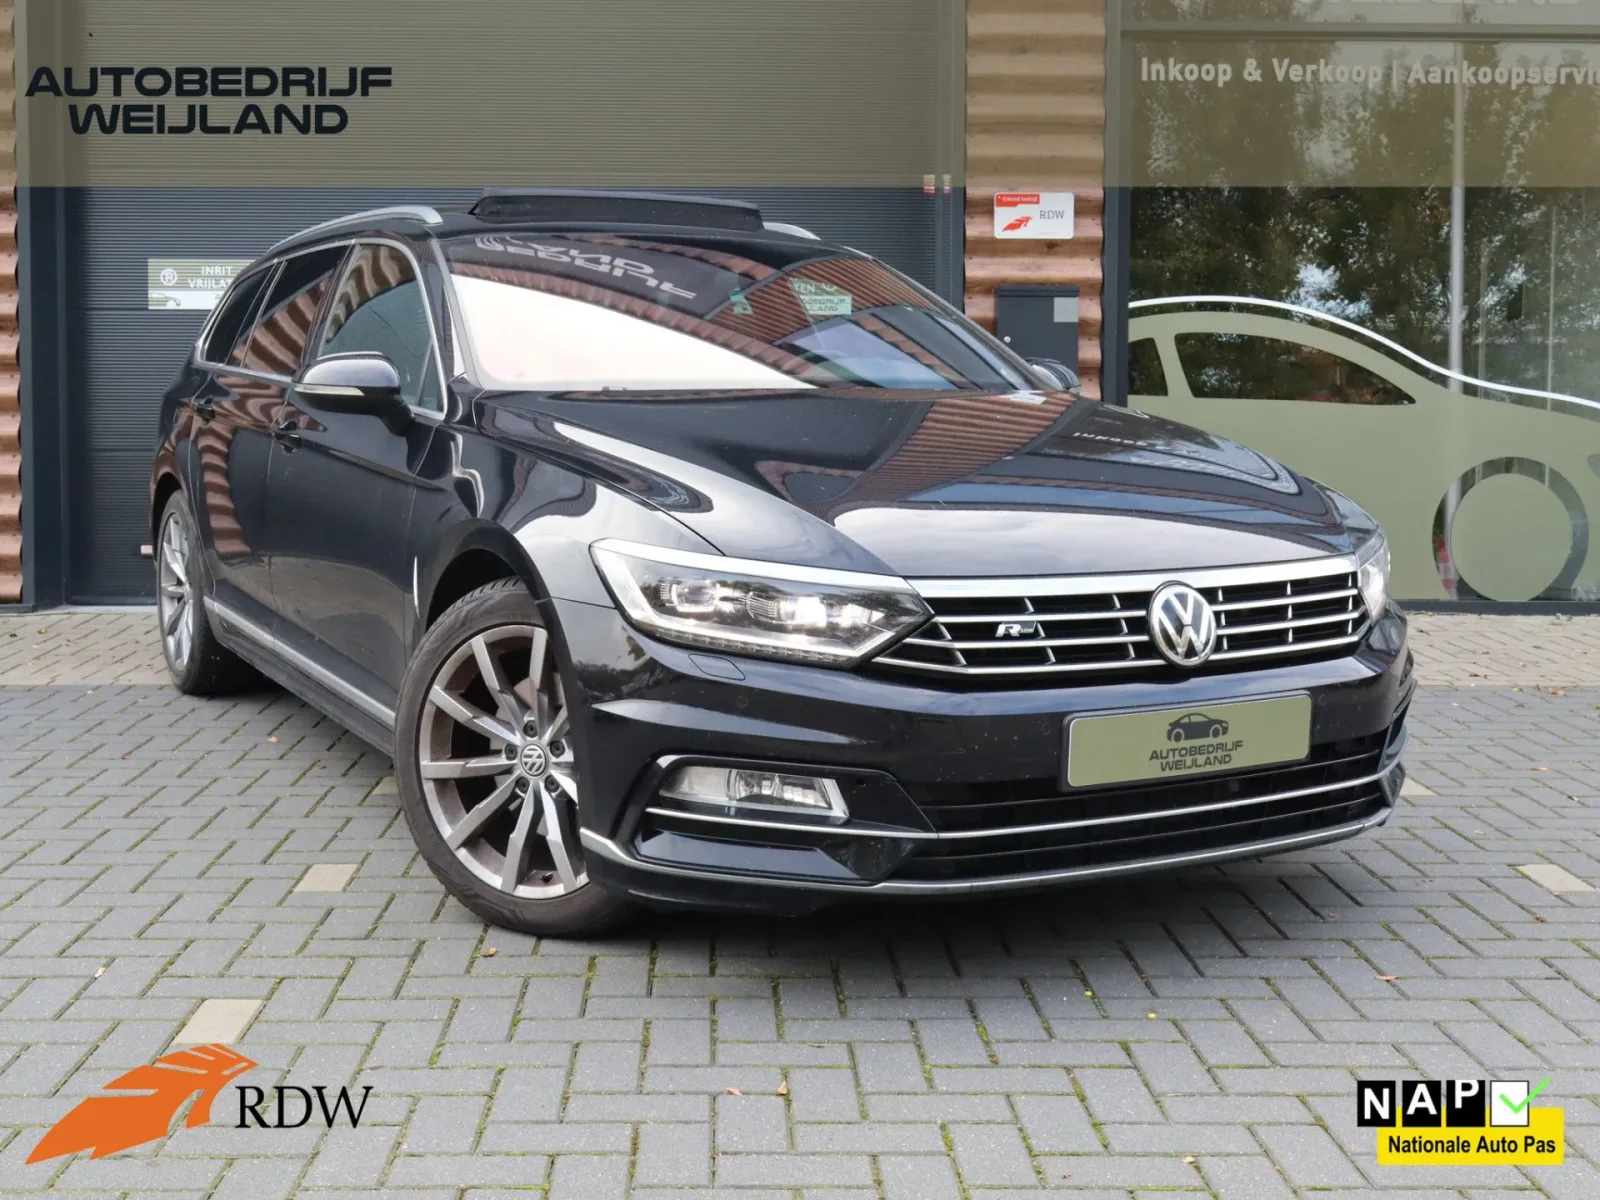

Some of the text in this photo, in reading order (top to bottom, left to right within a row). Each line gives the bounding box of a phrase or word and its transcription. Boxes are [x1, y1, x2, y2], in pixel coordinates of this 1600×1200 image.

[1141, 57, 1232, 87] Inkoop
[1243, 60, 1262, 82] &
[1272, 58, 1382, 89] Verkoop
[1040, 210, 1065, 220] RDW
[201, 265, 234, 276] INRIT
[1149, 740, 1244, 761] AUTOBEDRIJF
[1160, 754, 1232, 772] WEIJLAND
